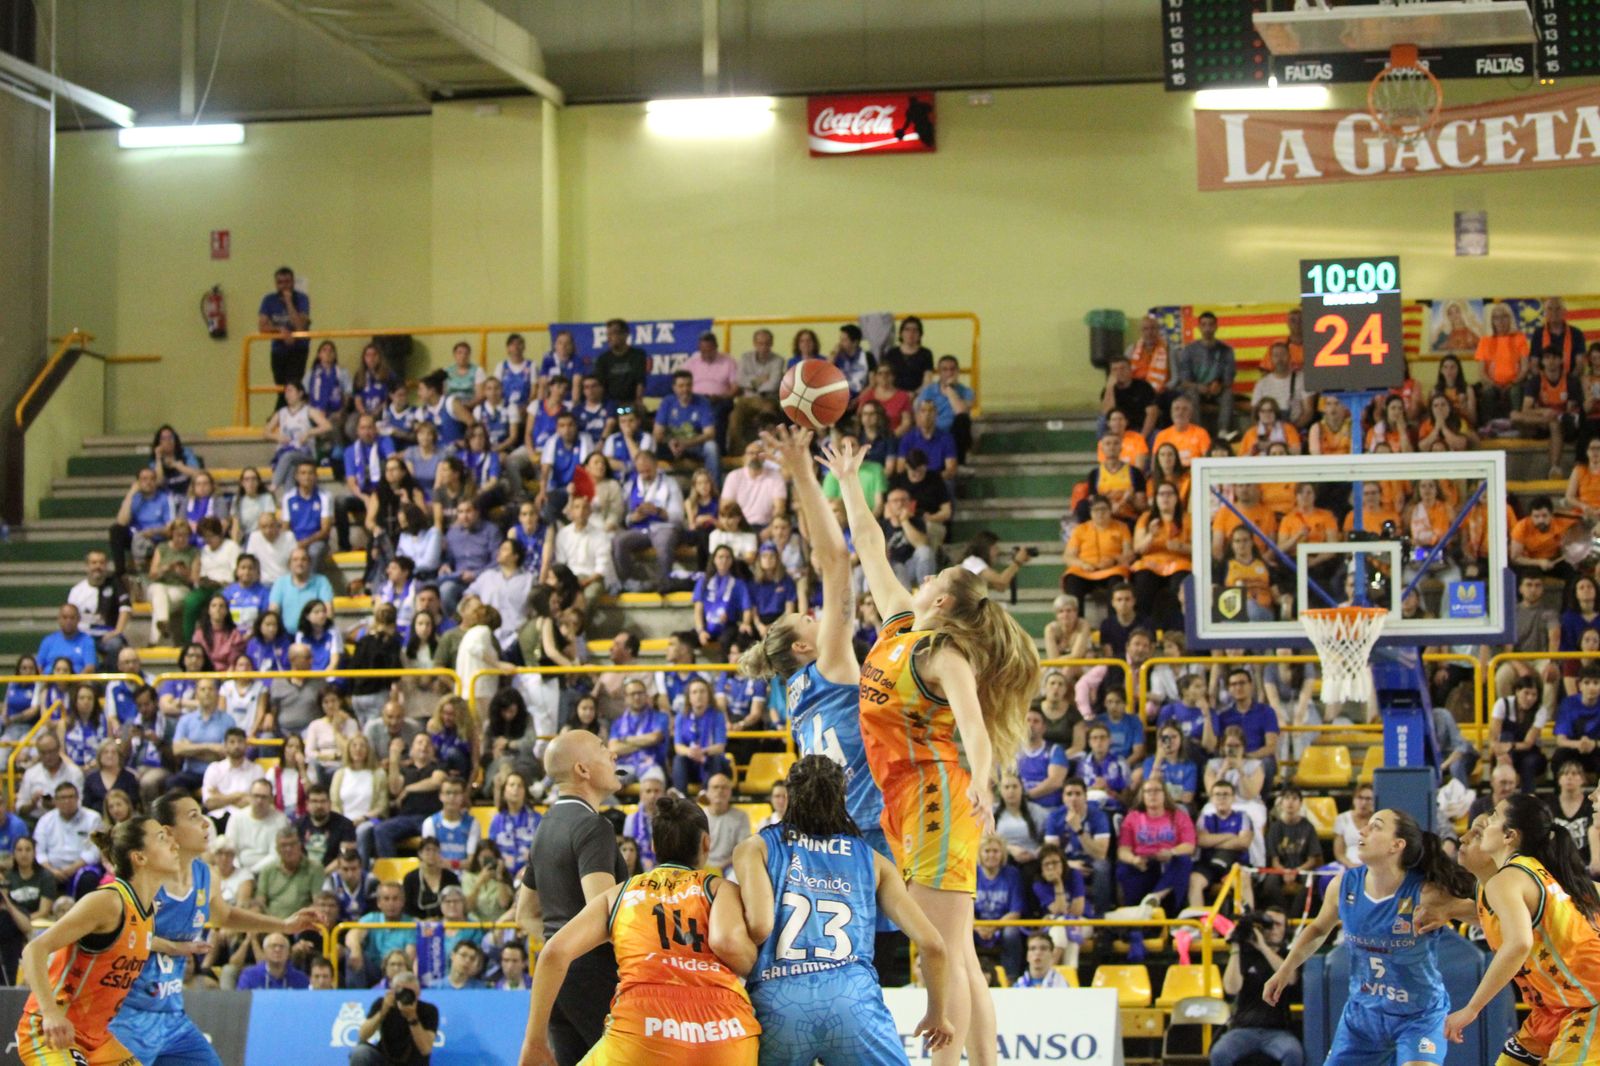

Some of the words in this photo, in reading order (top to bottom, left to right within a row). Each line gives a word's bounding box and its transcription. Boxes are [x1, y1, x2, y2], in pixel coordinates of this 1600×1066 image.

[1544, 13, 1558, 25] 12
[1170, 26, 1184, 38] 12
[1544, 29, 1559, 40] 13
[1545, 45, 1558, 56] 14
[1284, 64, 1334, 81] FALTAS
[1476, 57, 1525, 74] FALTAS
[1546, 60, 1560, 73] 15
[1307, 261, 1396, 294] 10:00
[1313, 313, 1390, 367] 24
[880, 678, 896, 690] del
[1397, 725, 1408, 768] MONDO
[786, 830, 852, 857] PRINCE
[651, 903, 704, 953] 14
[776, 892, 852, 961] 23
[1370, 957, 1386, 979] 5
[644, 1016, 747, 1044] PAMESA
